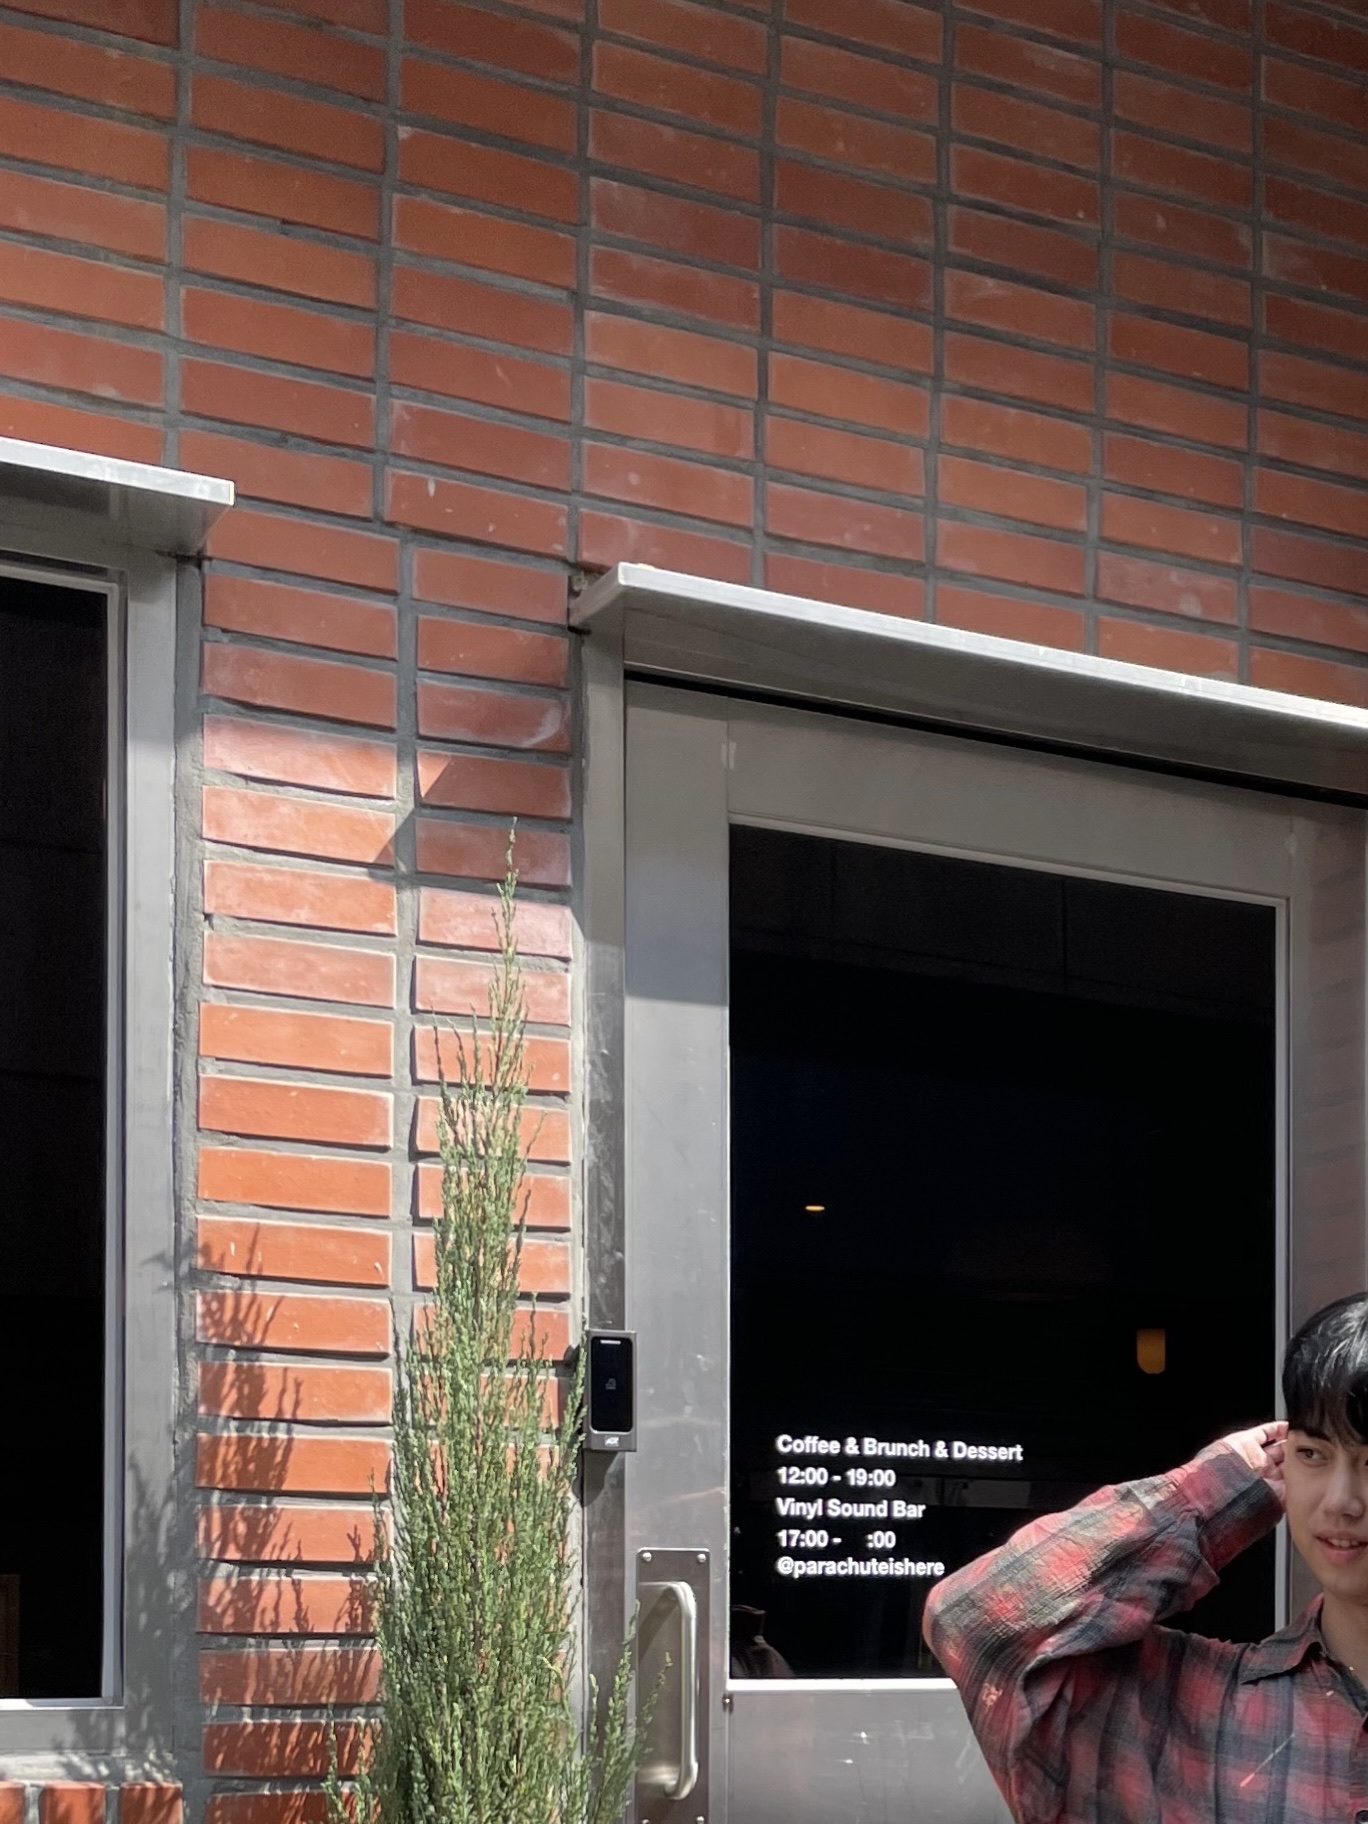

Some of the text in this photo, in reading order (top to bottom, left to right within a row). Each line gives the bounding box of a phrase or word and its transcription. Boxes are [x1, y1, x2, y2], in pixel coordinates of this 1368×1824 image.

[776, 1433, 1024, 1462] Coffee & Brunch & Dessert
[776, 1466, 829, 1486] 12:00
[846, 1467, 897, 1488] 19:00
[776, 1496, 927, 1521] Vinyl Sound Bar
[776, 1528, 829, 1549] 17:00
[776, 1555, 946, 1579] @parachuteishere
